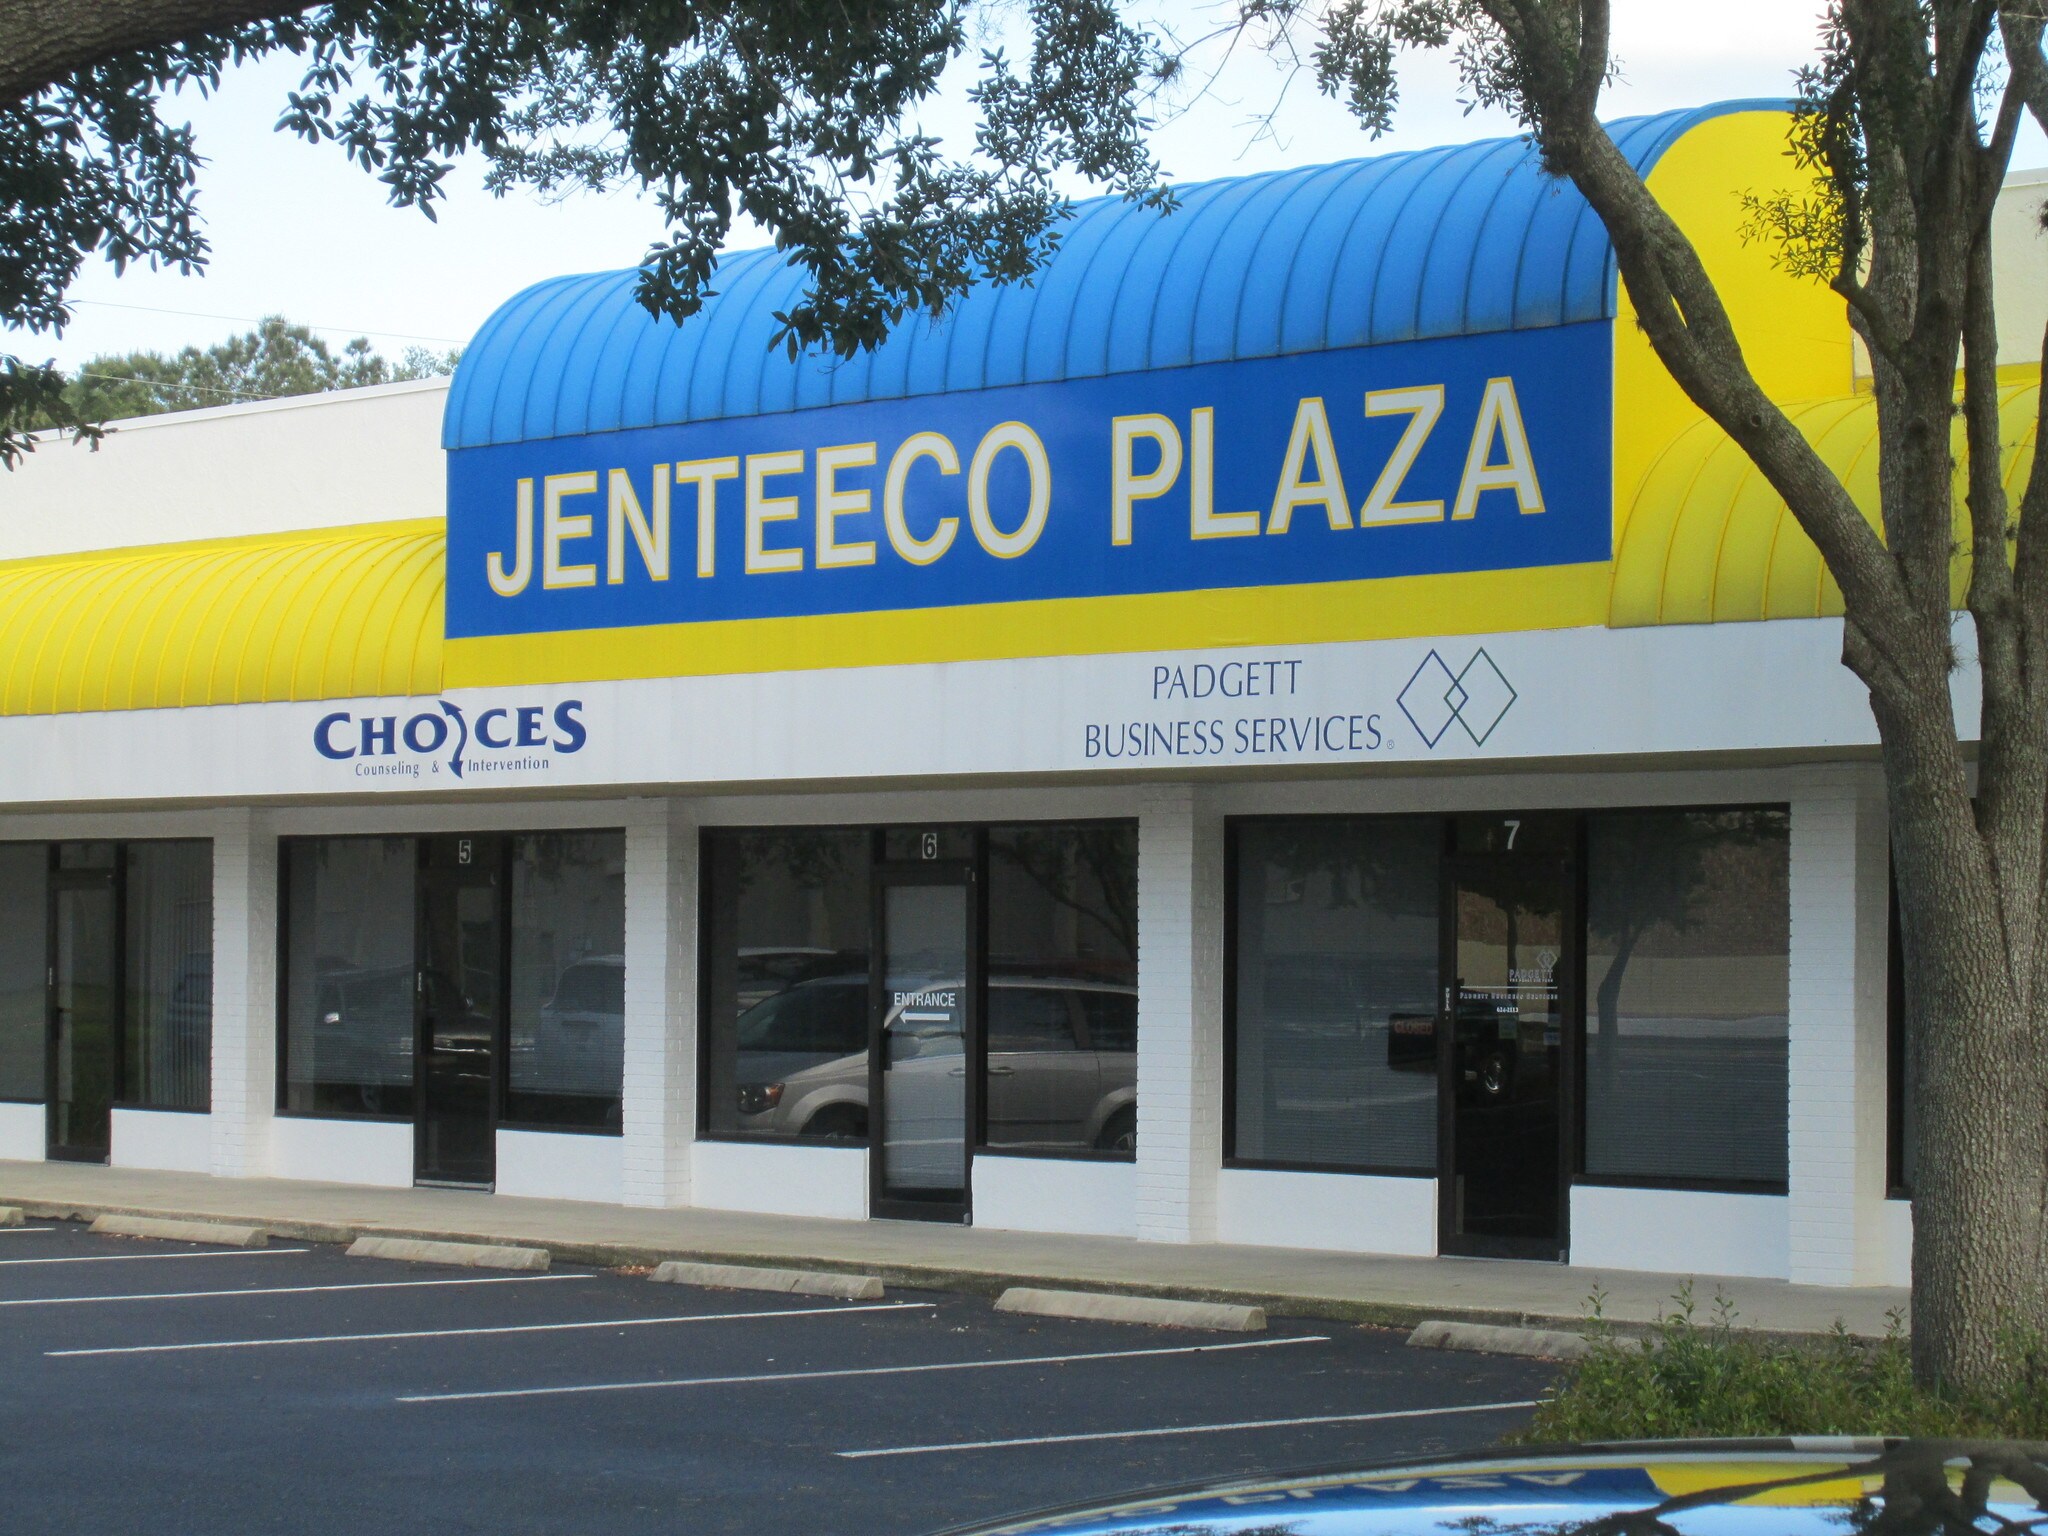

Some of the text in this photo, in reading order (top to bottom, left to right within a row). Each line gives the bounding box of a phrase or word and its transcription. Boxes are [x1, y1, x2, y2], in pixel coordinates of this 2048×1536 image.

[487, 376, 1546, 597] JENTEECO PLAZA
[1153, 660, 1302, 700] PADGETT
[313, 700, 587, 761] CHOICES
[1085, 719, 1225, 758] BUSINESS
[1234, 714, 1382, 754] SERVICES
[355, 755, 550, 778] Counseling & Intervention
[923, 834, 936, 859] 6
[1504, 820, 1521, 850] 7
[460, 840, 471, 863] 5
[1509, 969, 1553, 979] PADGETT
[894, 993, 956, 1007] ENTRANCE
